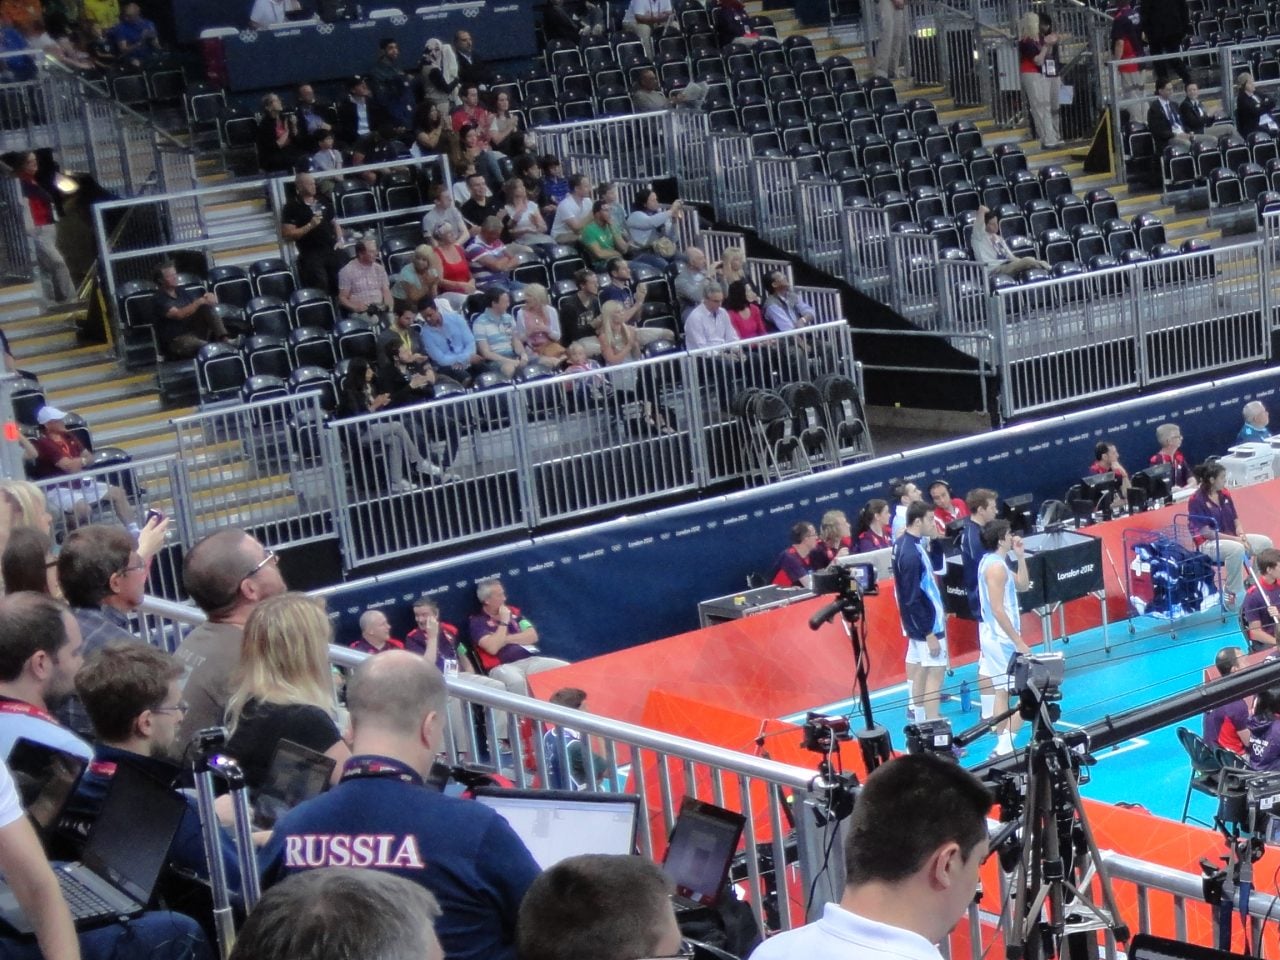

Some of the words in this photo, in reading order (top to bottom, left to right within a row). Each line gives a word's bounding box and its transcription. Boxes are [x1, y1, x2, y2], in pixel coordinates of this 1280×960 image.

[1057, 568, 1079, 581] London
[1080, 563, 1095, 575] 2012
[947, 585, 964, 596] London
[285, 833, 425, 869] RUSSIA
